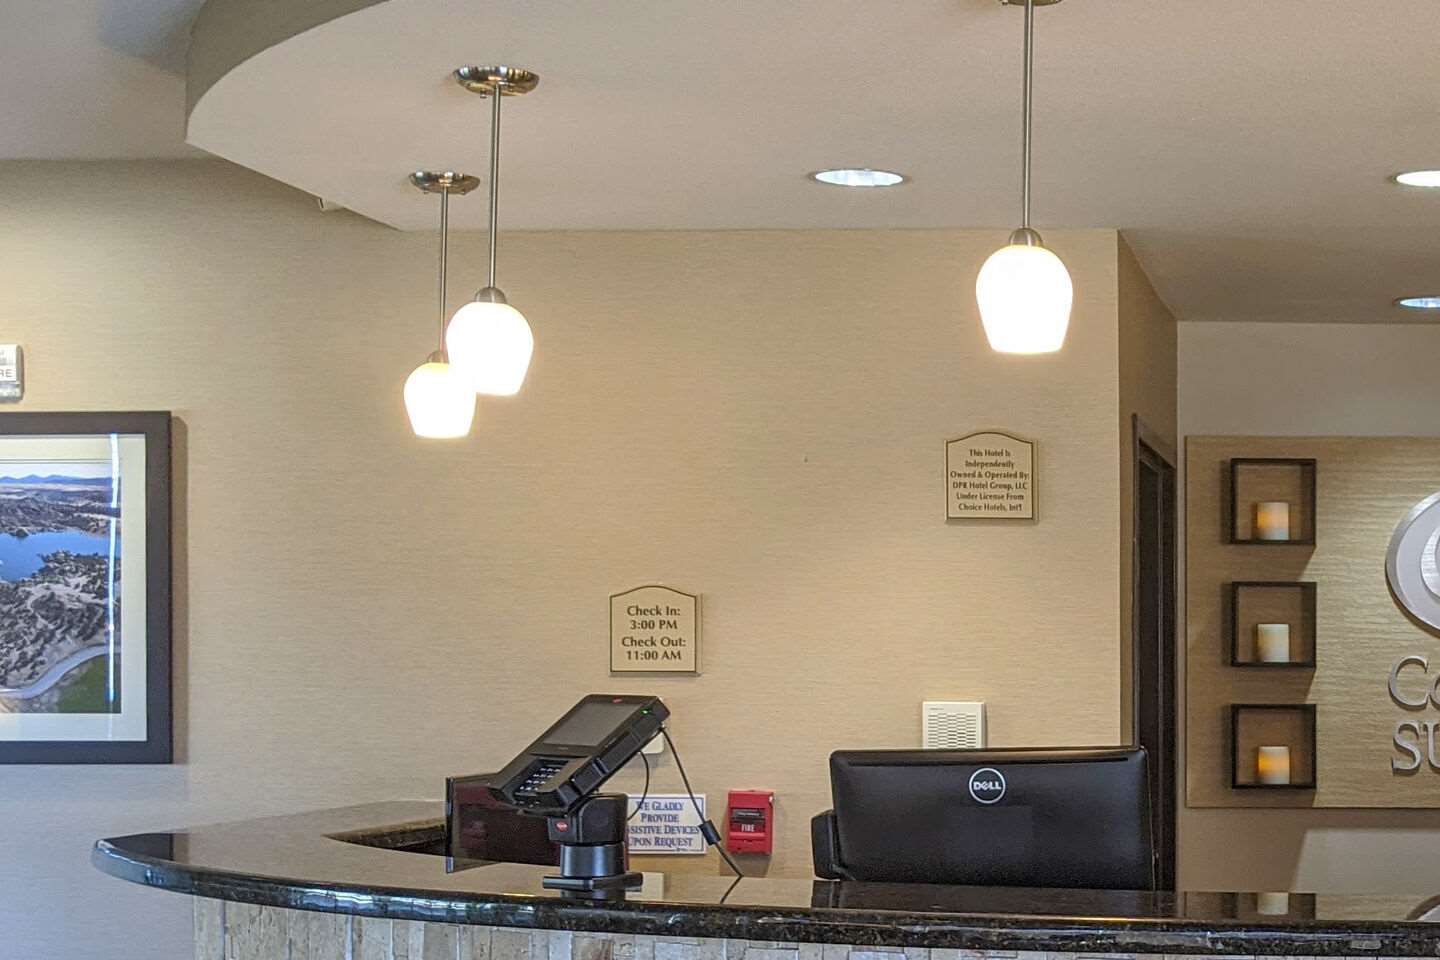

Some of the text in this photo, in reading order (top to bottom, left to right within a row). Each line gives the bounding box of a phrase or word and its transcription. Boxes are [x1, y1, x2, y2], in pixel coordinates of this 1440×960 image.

[969, 449, 983, 457] This
[984, 449, 1004, 457] Hotel
[965, 460, 1015, 470] Independently
[950, 470, 976, 478] Owned
[984, 470, 1018, 480] Operated
[969, 481, 988, 489] Hotel
[989, 481, 1014, 491] Group,
[1015, 482, 1028, 490] LLC
[956, 492, 1025, 500] Under License From
[958, 503, 983, 511] Choice
[626, 605, 681, 616] Check In:
[630, 620, 678, 630] 3:00 PM
[621, 636, 687, 647] Check Out:
[626, 650, 682, 660] 11:00 AM
[973, 781, 1002, 790] DELL
[652, 800, 684, 811] GLADLY
[640, 812, 680, 823] PROVIDE
[664, 825, 700, 834] DEVICES
[741, 824, 755, 832] FIRE
[655, 836, 693, 848] REQUEST
